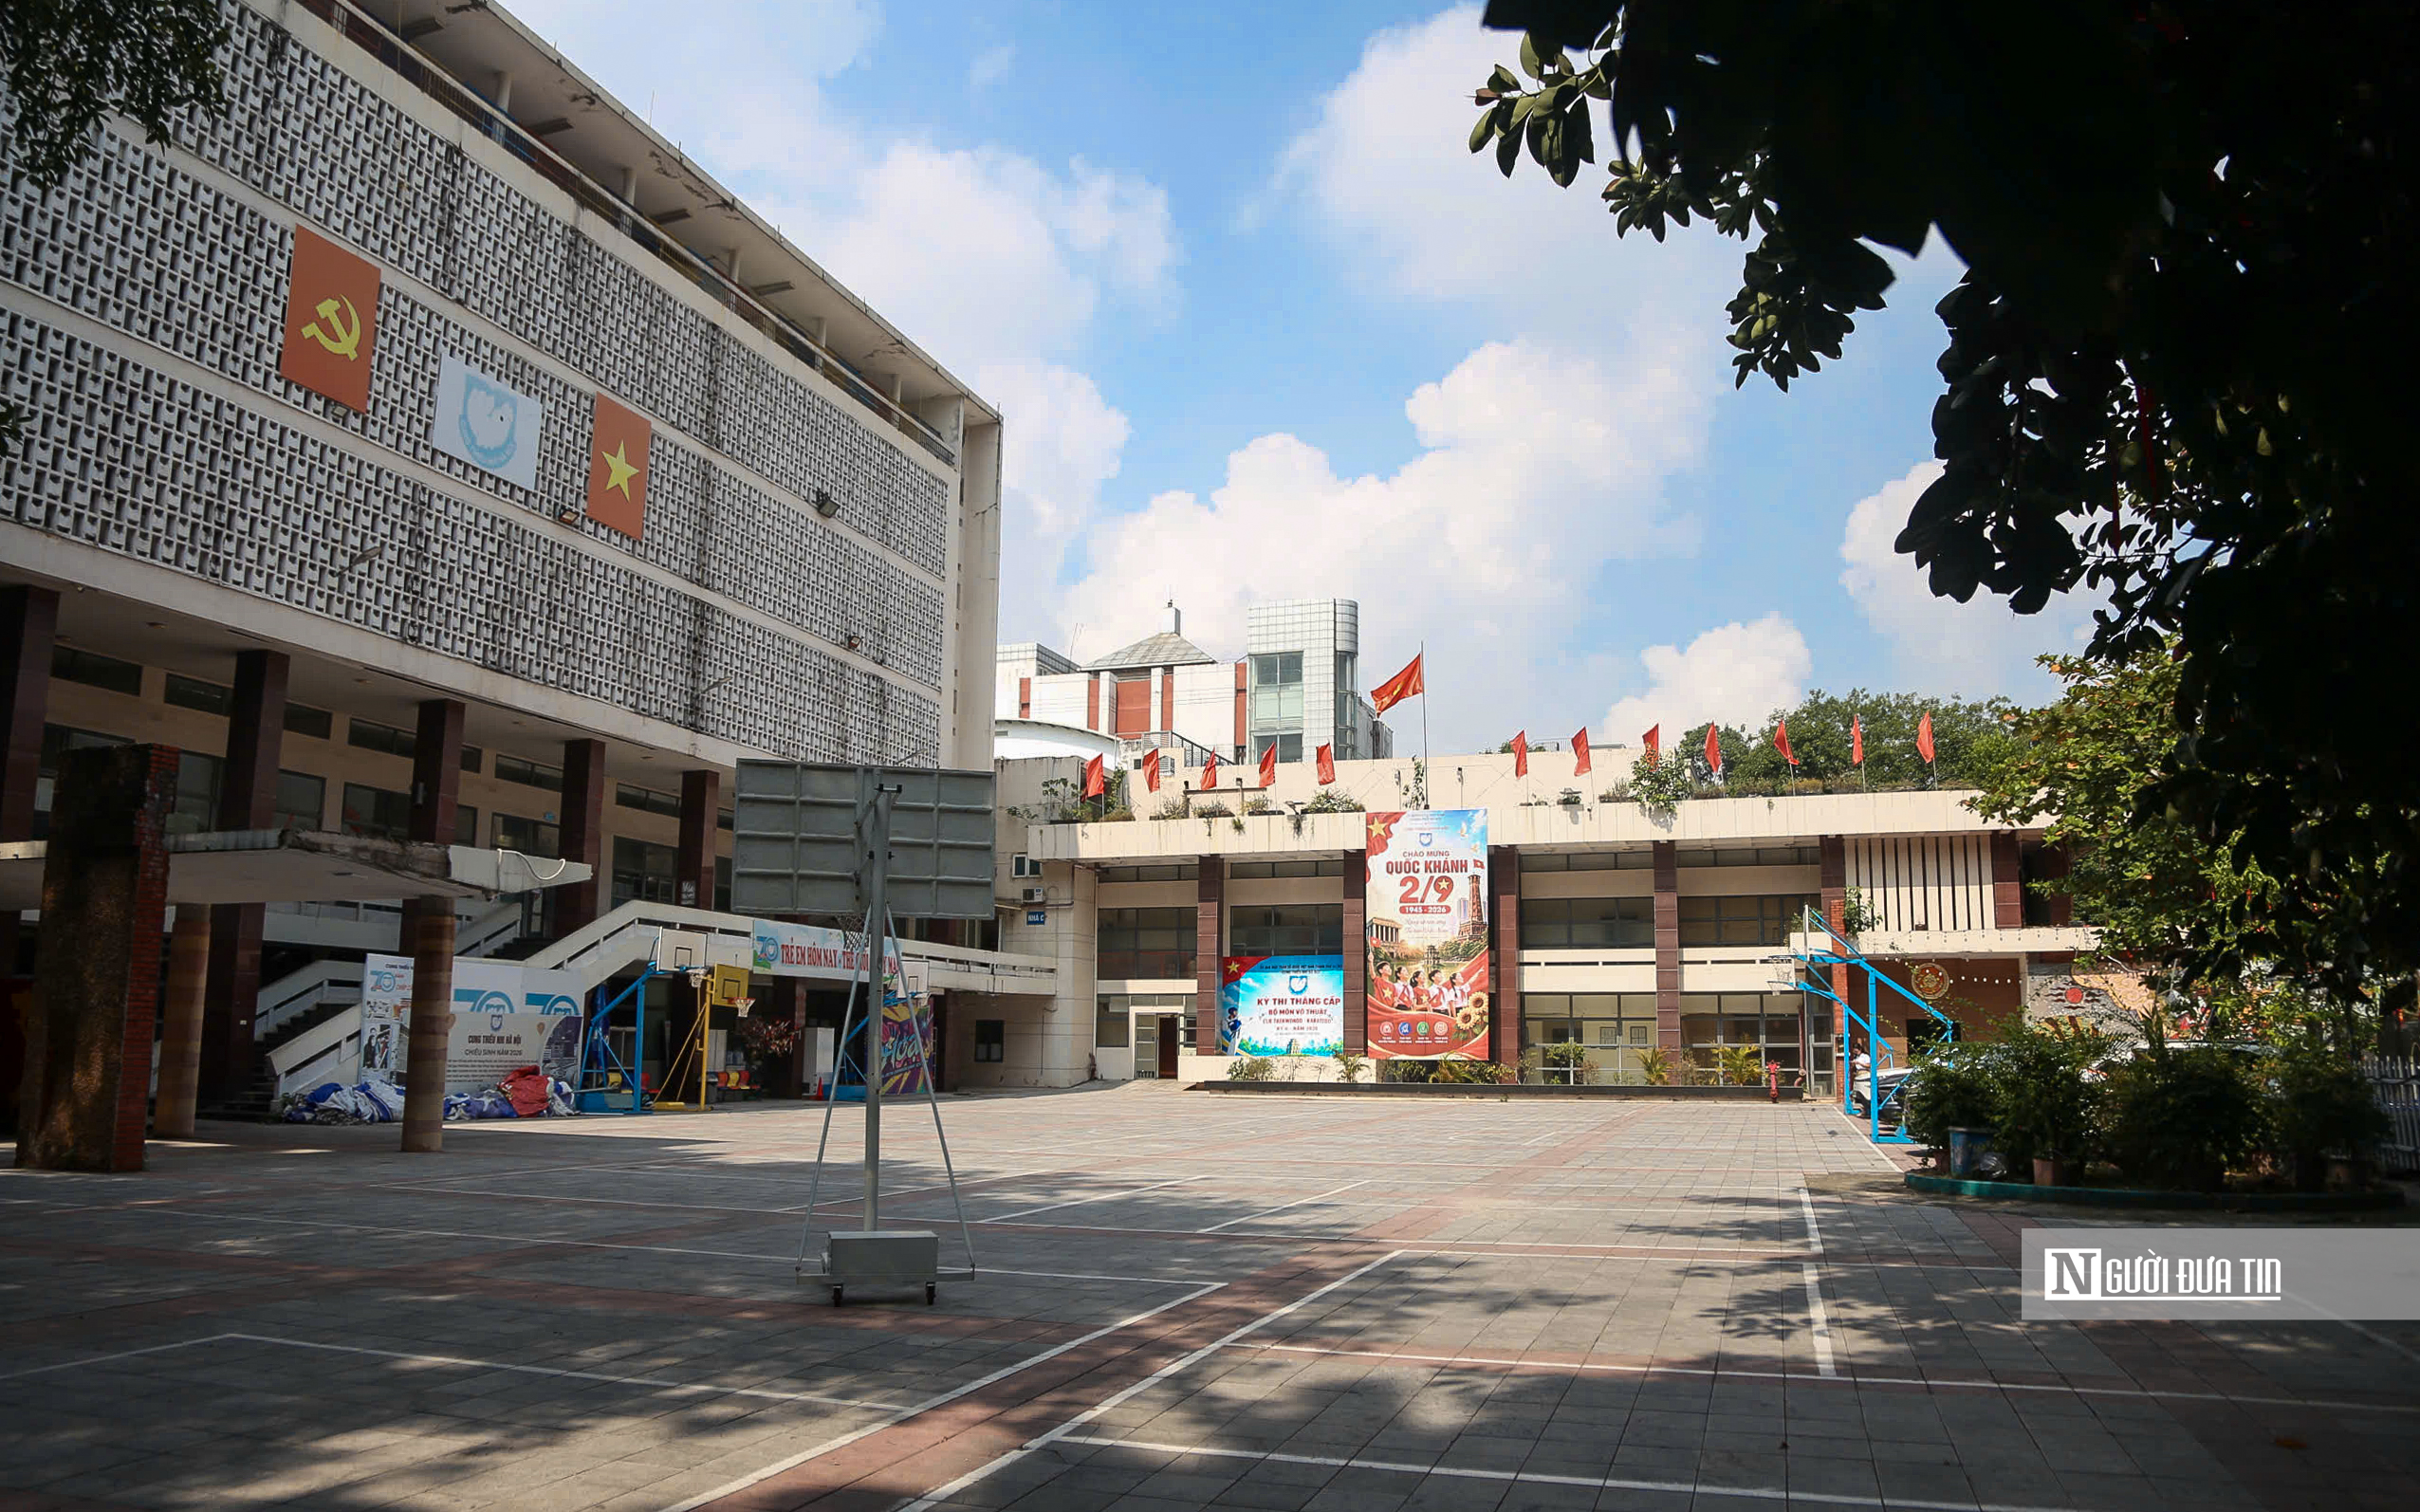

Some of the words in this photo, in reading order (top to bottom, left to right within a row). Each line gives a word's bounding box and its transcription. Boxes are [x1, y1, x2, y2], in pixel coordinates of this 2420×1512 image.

[1386, 857, 1420, 875] QUỐC
[1424, 857, 1469, 873] KHÁNH
[1399, 876, 1454, 903] 2/9
[1027, 913, 1039, 922] NHÀ
[781, 936, 794, 965] TRẺ
[796, 946, 806, 966] EM
[807, 941, 822, 967] HÔM
[823, 949, 838, 968] NAY
